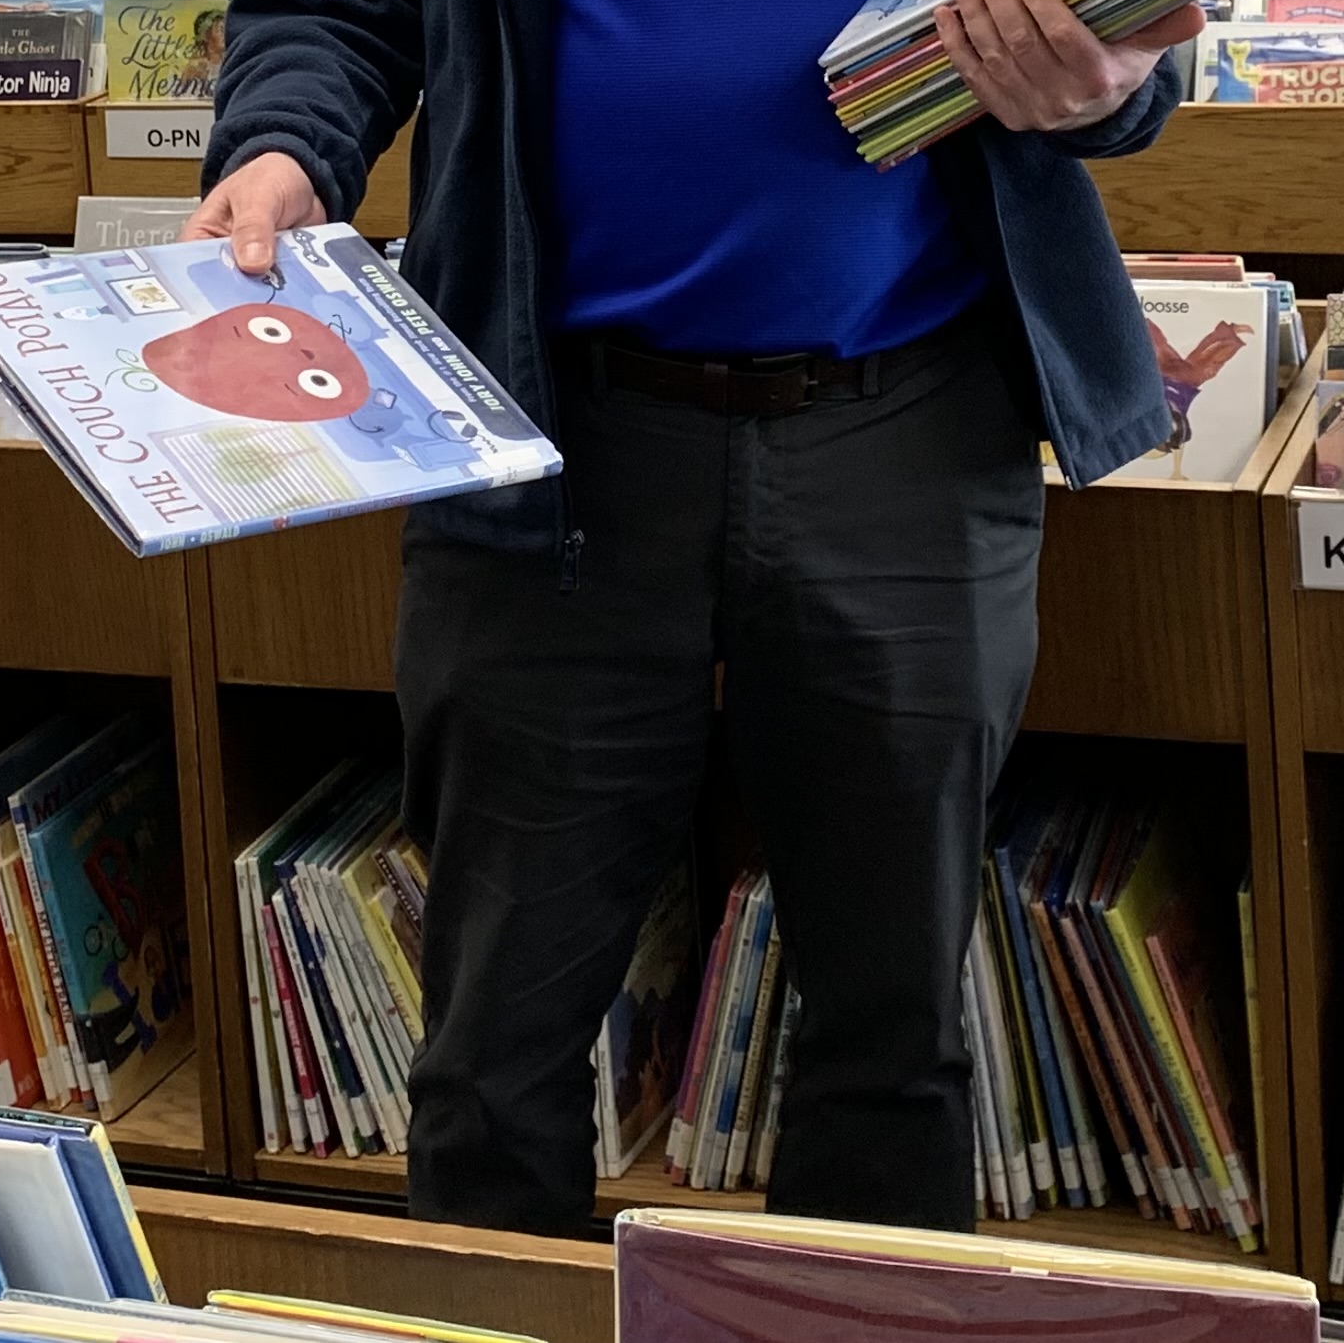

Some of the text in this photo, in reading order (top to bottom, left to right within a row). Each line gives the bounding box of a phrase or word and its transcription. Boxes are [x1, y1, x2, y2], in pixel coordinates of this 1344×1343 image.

[12, 29, 31, 37] THE
[118, 5, 175, 35] The
[18, 41, 55, 56] Ghost
[28, 71, 71, 99] Ninja
[147, 130, 201, 147] O-PN
[360, 263, 409, 309] OSWALD
[401, 308, 435, 337] PETE
[441, 353, 478, 386] JOHN
[469, 383, 506, 413] JORY
[38, 364, 150, 465] COUCH
[129, 470, 204, 524] THE
